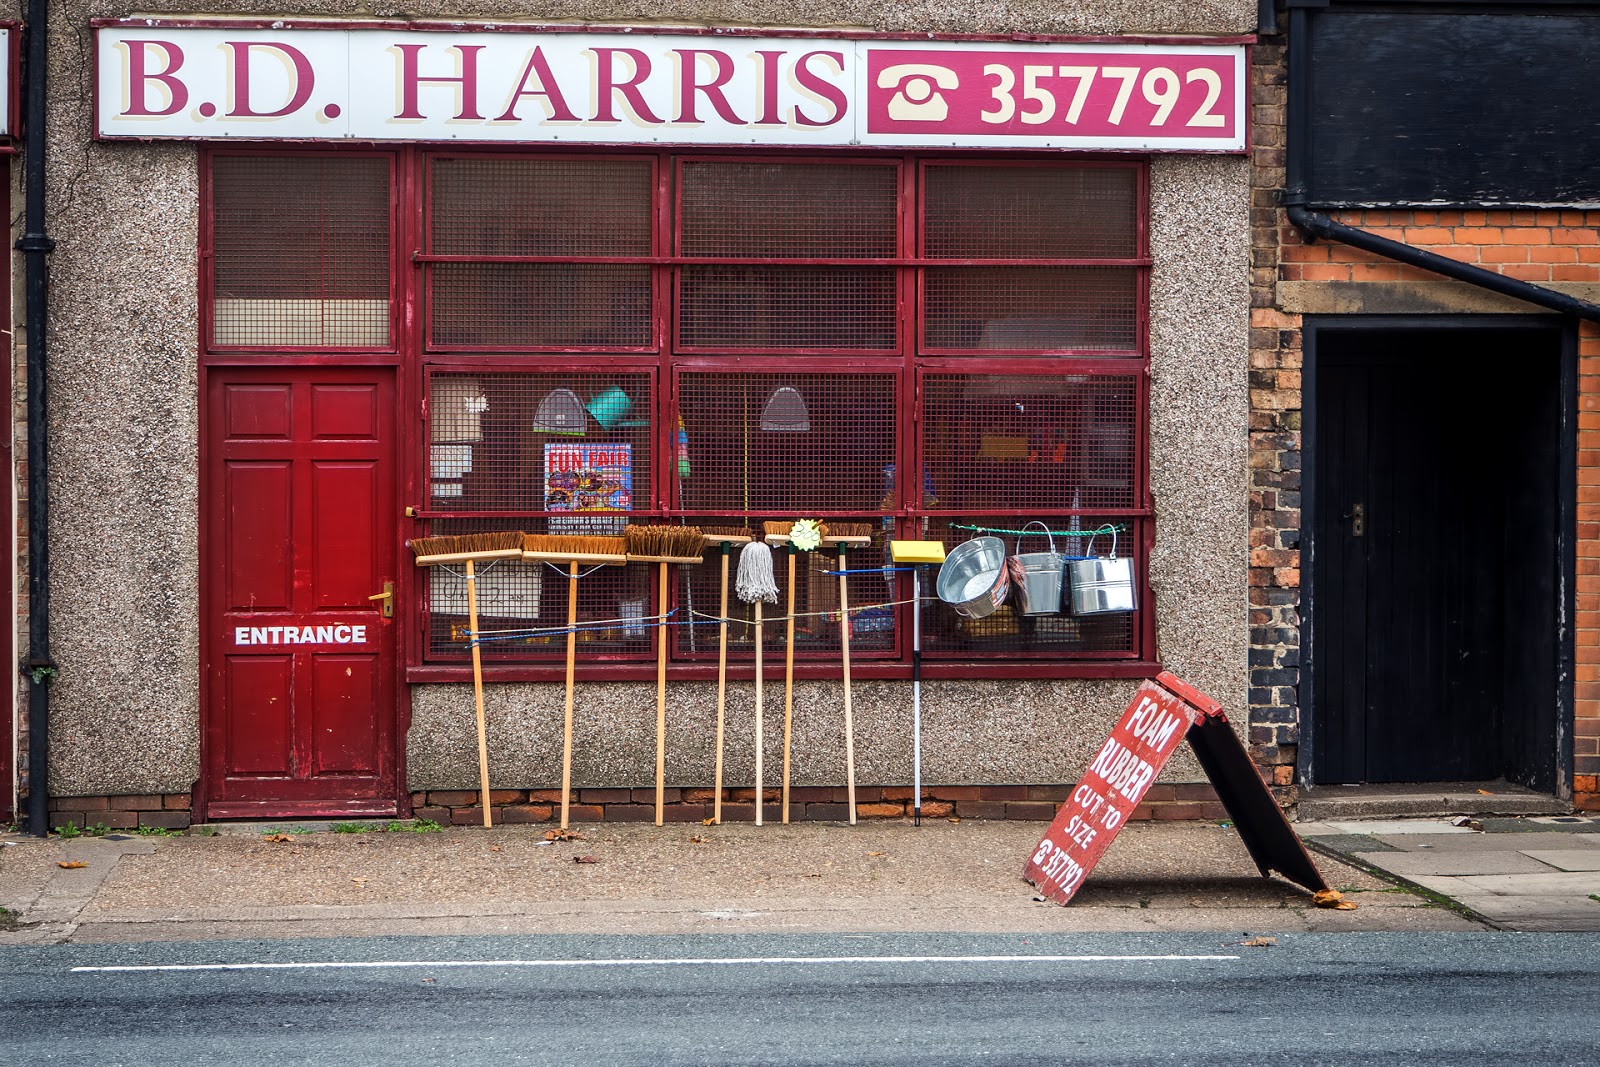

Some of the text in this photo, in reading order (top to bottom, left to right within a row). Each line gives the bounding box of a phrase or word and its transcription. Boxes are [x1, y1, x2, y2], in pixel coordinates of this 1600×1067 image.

[115, 39, 849, 130] B.D. HARRIS
[980, 63, 1226, 128] 357792
[548, 451, 629, 473] FUN FAIR
[235, 625, 367, 645] ENTRANCE
[1124, 696, 1181, 753] FOAM
[1089, 736, 1154, 803] RUBBER
[1073, 784, 1121, 830] CUT TO
[1063, 814, 1098, 850] SIZE
[1041, 846, 1083, 895] 357792
